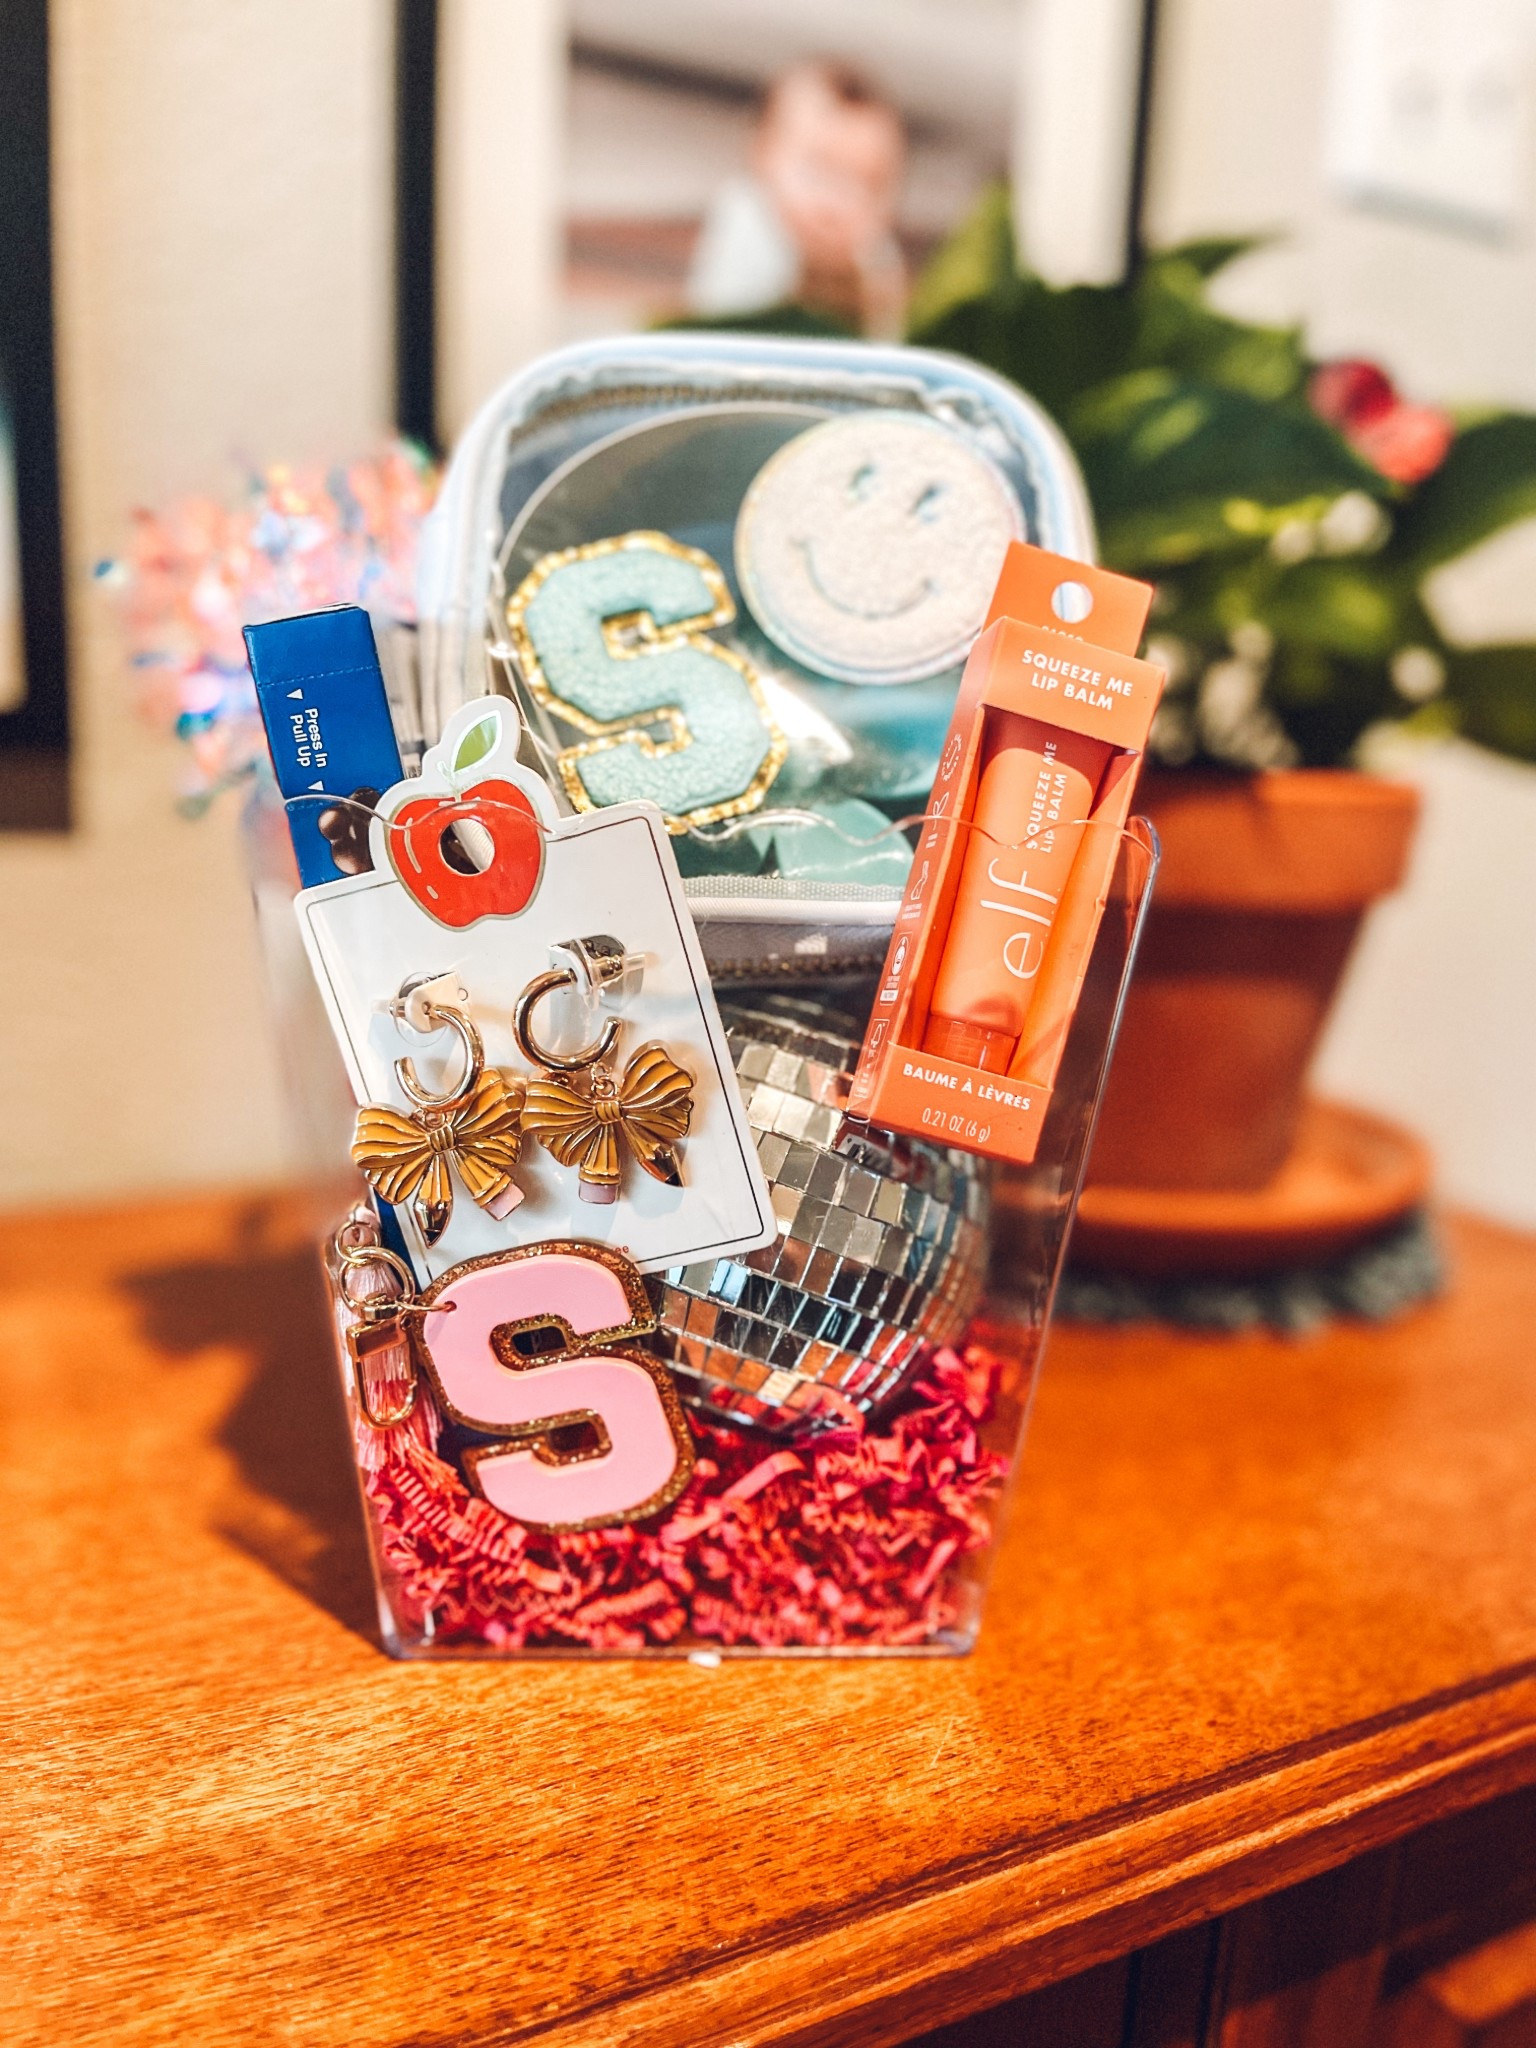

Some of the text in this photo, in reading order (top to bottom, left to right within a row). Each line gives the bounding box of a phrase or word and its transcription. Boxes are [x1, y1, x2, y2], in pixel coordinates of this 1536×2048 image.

[506, 529, 787, 835] S
[1022, 649, 1133, 696] SQUEEZE ME
[1031, 672, 1113, 711] LIP BALM
[290, 714, 312, 767] Pull Up
[305, 708, 328, 768] Press In
[1024, 741, 1057, 850] SQUEEZE ME
[1040, 773, 1068, 854] LIP BALM
[903, 1063, 958, 1089] BAUME
[961, 1078, 973, 1094] À
[977, 1084, 1032, 1111] LÈVRES
[921, 1107, 991, 1143] 0.21 OZ (6 g)
[414, 1239, 696, 1533] S
